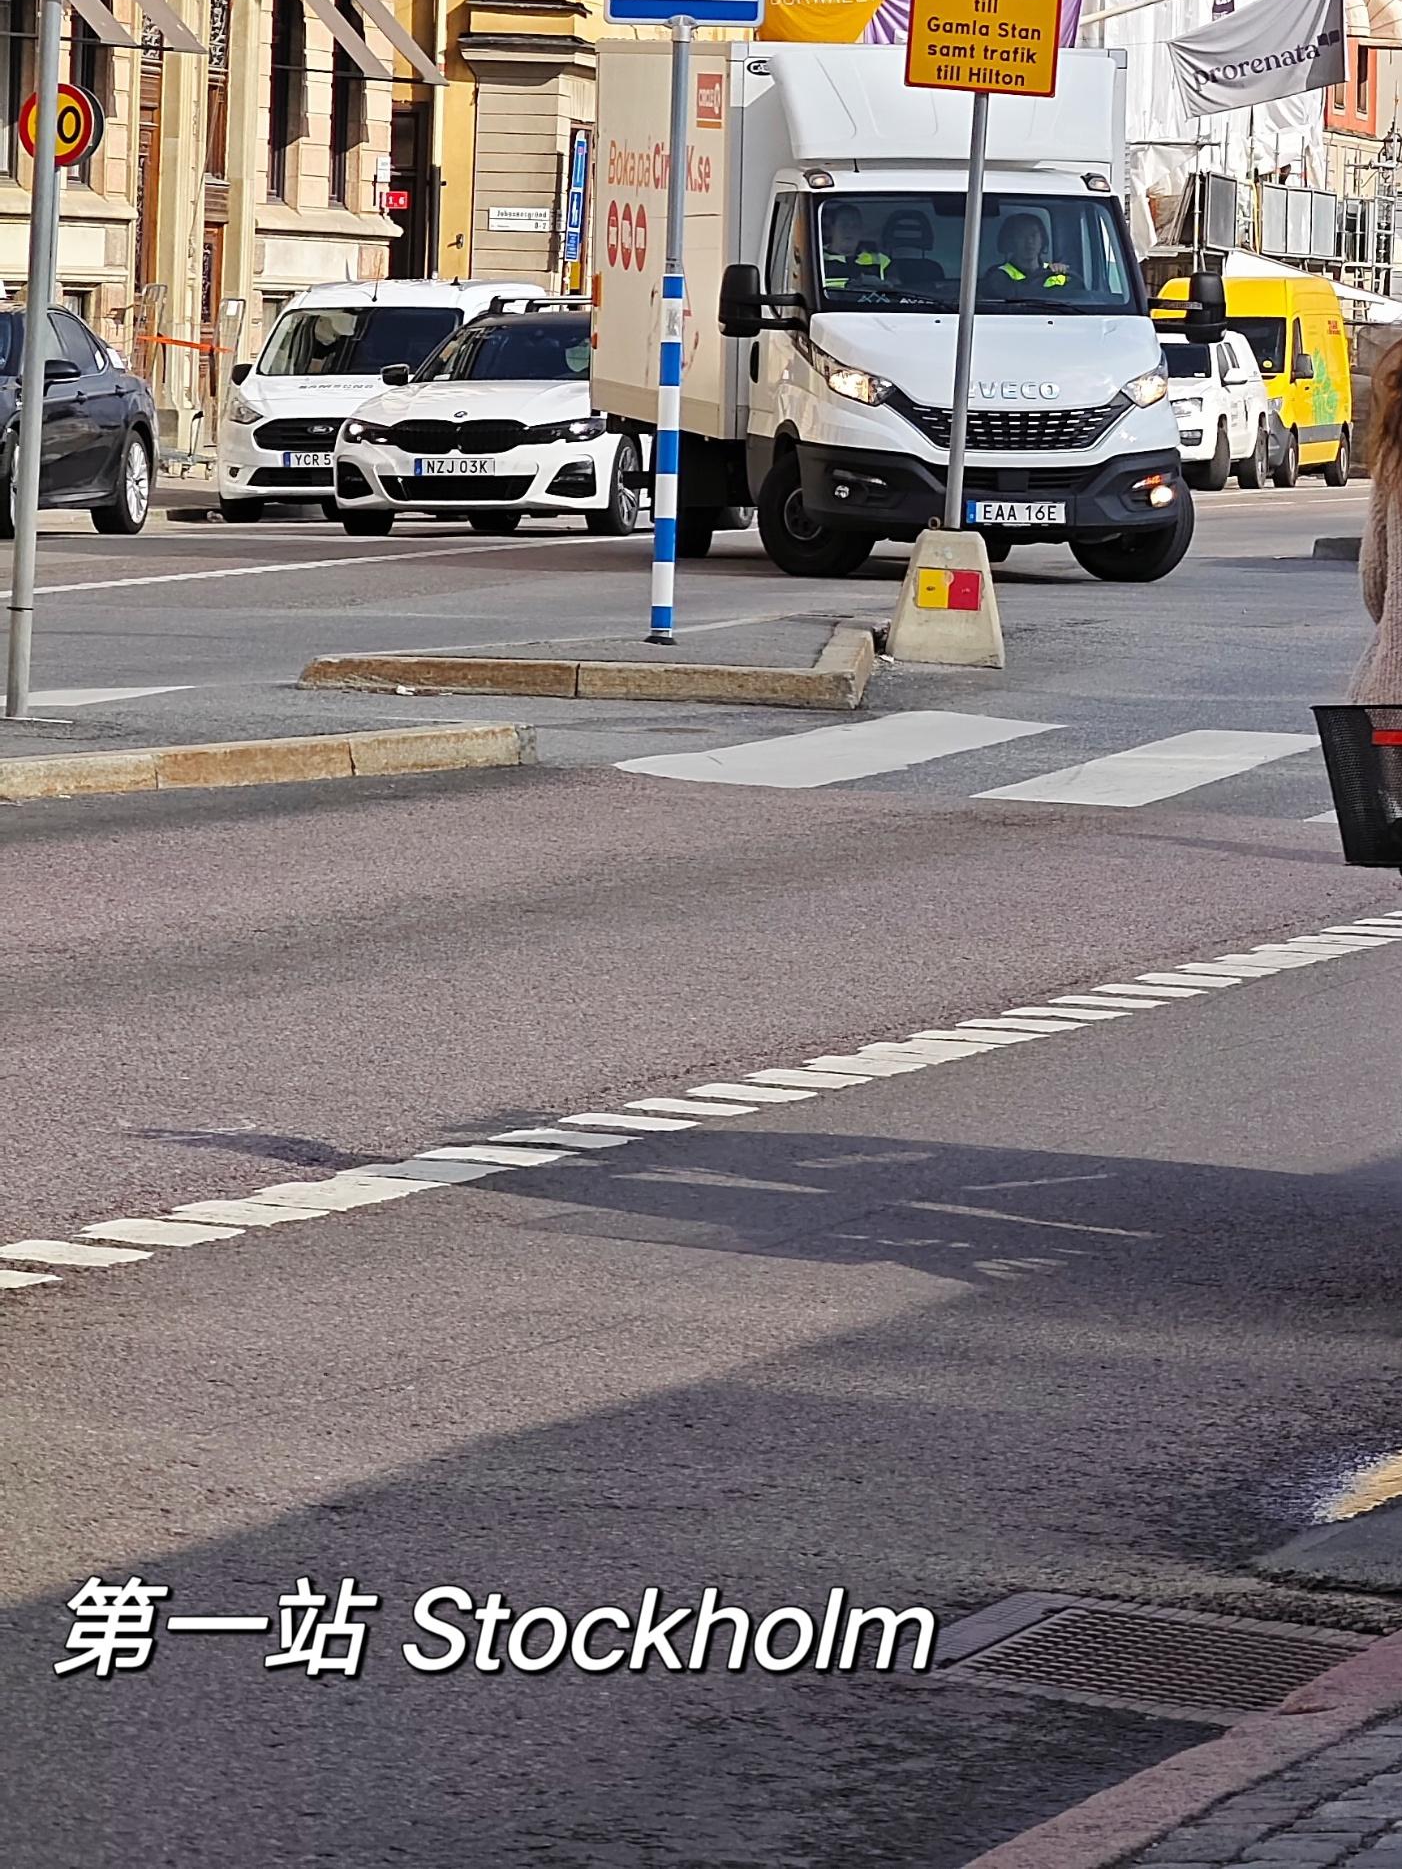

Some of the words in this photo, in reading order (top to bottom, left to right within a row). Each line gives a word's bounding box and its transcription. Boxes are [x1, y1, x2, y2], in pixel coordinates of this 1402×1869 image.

[927, 16, 990, 37] Gamla
[998, 23, 1042, 41] Stan
[927, 43, 976, 59] samt
[983, 46, 1038, 64] trafik
[936, 65, 961, 82] till
[968, 67, 1026, 87] Hilton
[1192, 42, 1321, 92] prorenata
[57, 105, 82, 144] 0
[608, 140, 636, 185] Boka
[295, 453, 320, 466] YCR
[426, 460, 455, 474] NZJ
[460, 460, 488, 474] 03K
[983, 504, 1017, 521] EAA
[1025, 504, 1057, 521] 16E
